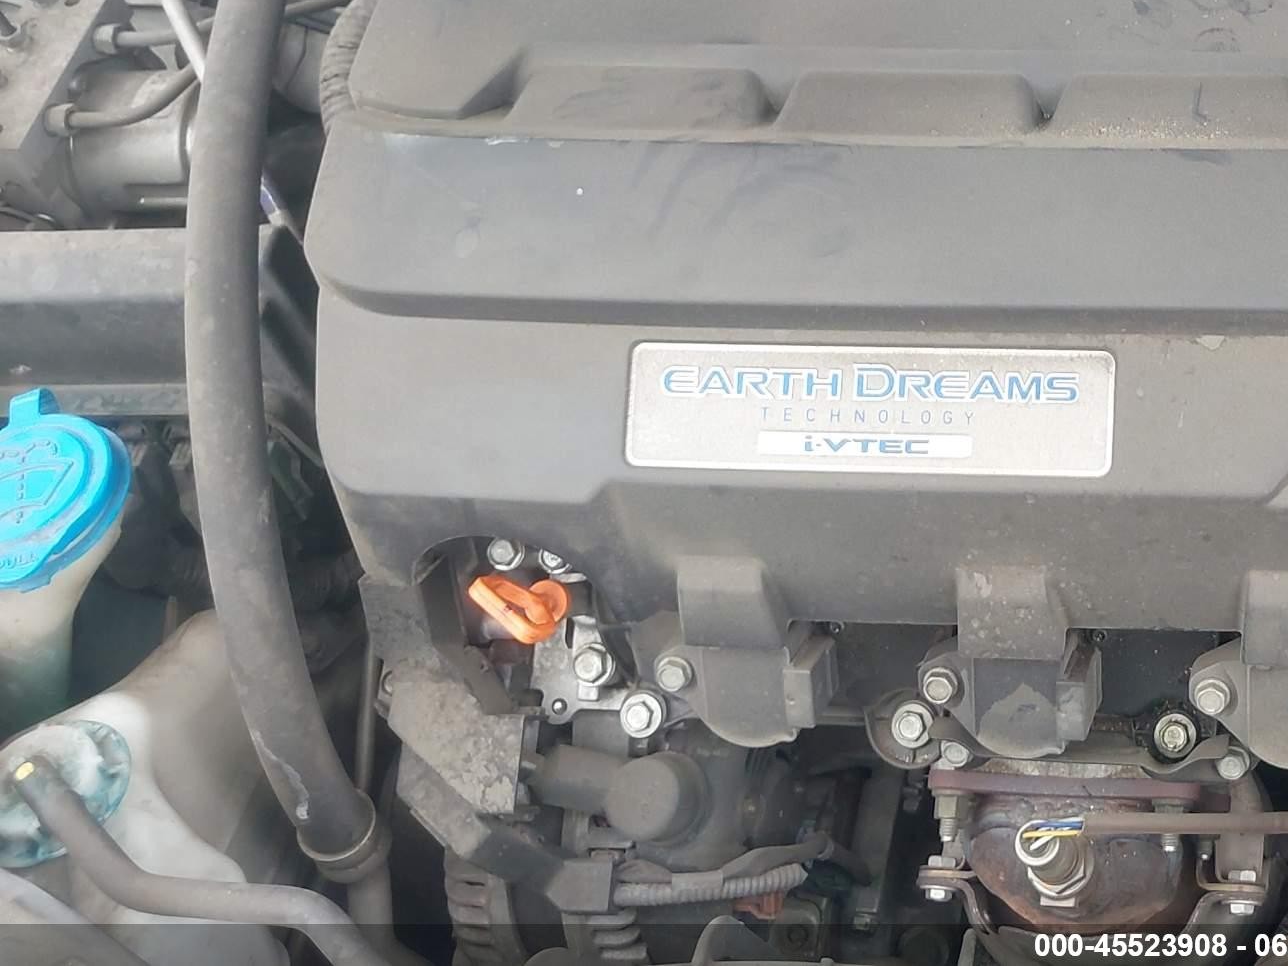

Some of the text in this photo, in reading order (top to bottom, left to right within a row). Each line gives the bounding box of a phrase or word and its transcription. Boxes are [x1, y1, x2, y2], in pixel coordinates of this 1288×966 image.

[662, 363, 1081, 404] EARTH DREAMS
[761, 408, 975, 426] TECHNOLOGY
[804, 435, 929, 455] i-VTEC
